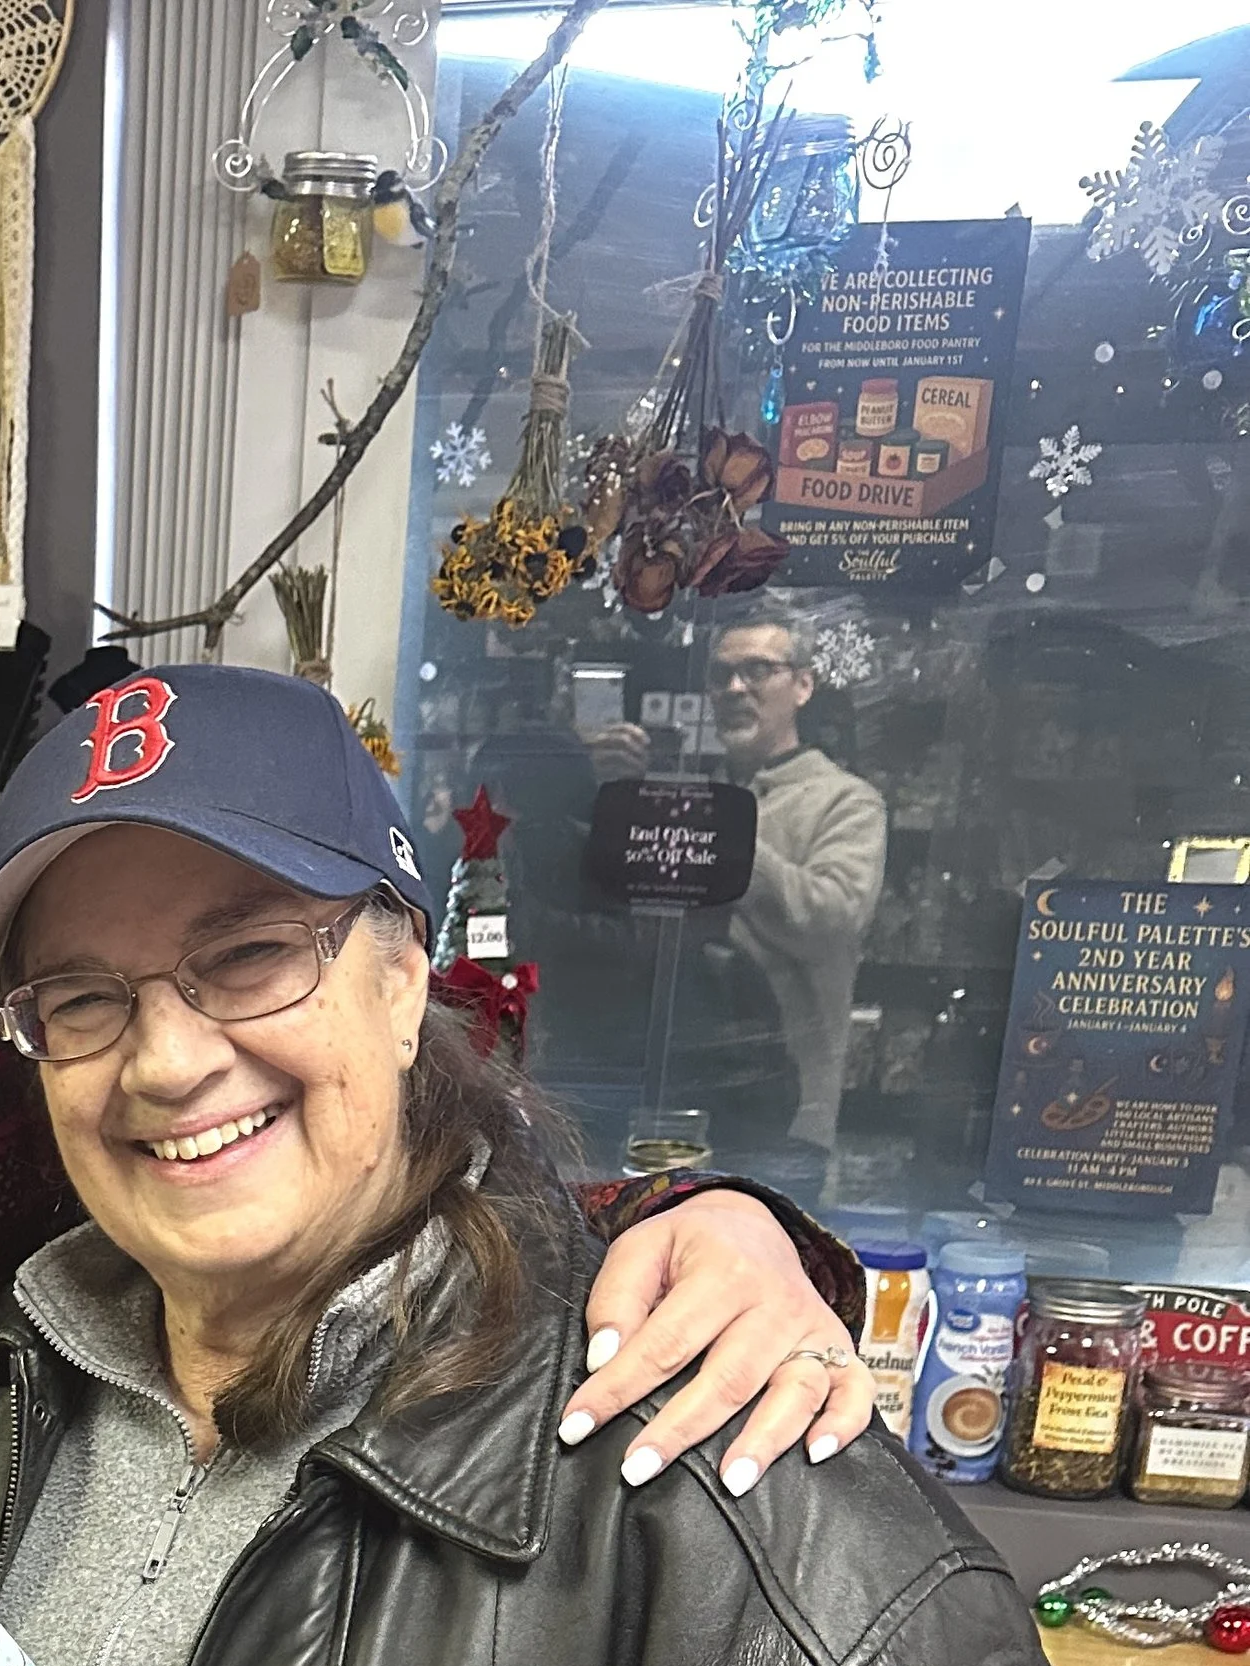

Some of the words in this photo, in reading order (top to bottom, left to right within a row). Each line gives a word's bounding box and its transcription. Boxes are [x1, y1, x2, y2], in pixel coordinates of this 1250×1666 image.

[844, 271, 879, 290] ARE
[883, 267, 994, 289] COLLECTING
[821, 290, 976, 313] NON-PERISHABLE
[842, 315, 891, 334] FOOD
[896, 313, 951, 332] ITEMS
[801, 342, 823, 354] FOR
[824, 341, 842, 353] THE
[844, 339, 909, 352] MIDDLEBORO
[911, 338, 939, 350] FOOD
[941, 337, 981, 349] PANTRY
[818, 358, 845, 369] FROM
[846, 357, 871, 368] NOW
[872, 356, 899, 367] UNTIL
[901, 355, 944, 366] JANUARY
[921, 387, 972, 409] CEREAL
[798, 411, 833, 426] ELBOW
[801, 477, 853, 501] FOOD
[857, 483, 916, 508] DRIVE
[779, 521, 812, 533] BRING
[814, 520, 827, 532] IN
[828, 520, 851, 531] ANY
[852, 519, 941, 531] NON-PERISHABLE
[943, 518, 970, 530] ITEM
[809, 534, 829, 546] GET
[831, 533, 847, 545] 5%
[849, 533, 870, 545] OFF
[871, 532, 900, 545] YOUR
[901, 531, 958, 544] PURCHASE
[838, 548, 902, 572] Soulful
[70, 678, 179, 806] B
[1120, 891, 1169, 915] THE
[1027, 919, 1129, 944] SOULFUL
[1135, 923, 1250, 949] PALETTE'S
[1077, 947, 1126, 969] 2ND
[1133, 950, 1193, 972] YEAR
[1050, 970, 1208, 997] ANNIVERSARY
[1057, 994, 1201, 1020] CELEBRATION
[1066, 1019, 1115, 1031] JANUARY
[1133, 1111, 1164, 1122] LOCAL
[1016, 1147, 1091, 1162] CELEBRATION
[1131, 1154, 1179, 1167] JANUARY
[1080, 1163, 1100, 1175] AM
[1118, 1166, 1138, 1178] PM
[1174, 1295, 1227, 1319] POLE
[1139, 1319, 1159, 1349] &
